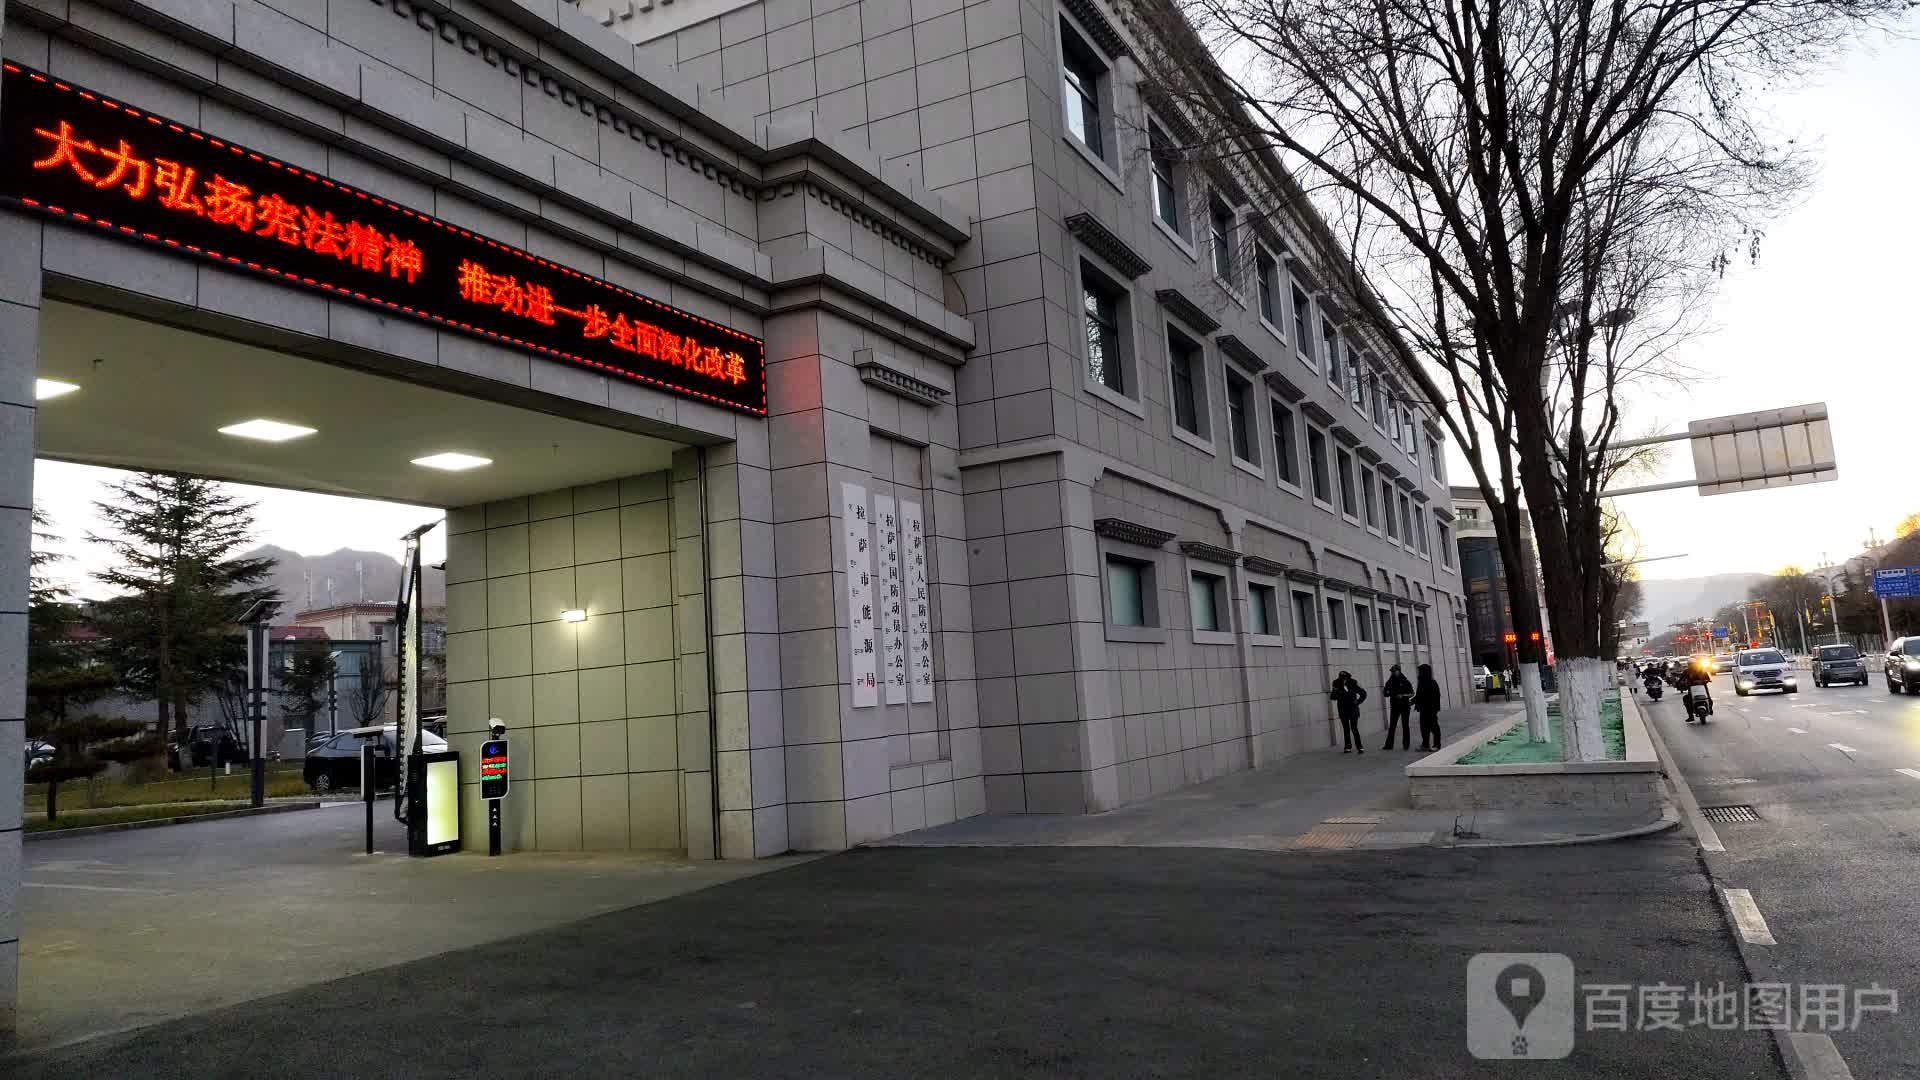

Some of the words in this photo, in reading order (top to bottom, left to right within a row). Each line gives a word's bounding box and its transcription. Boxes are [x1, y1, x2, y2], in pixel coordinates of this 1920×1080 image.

[34, 120, 423, 283] 大力弘扬宪法精神
[458, 258, 746, 385] 推动进一步全面深化改革
[856, 505, 876, 688] 拉萨市能源局
[885, 514, 905, 687] 拉萨市国防动员办公室
[912, 519, 932, 687] 拉萨市人民防空办公室
